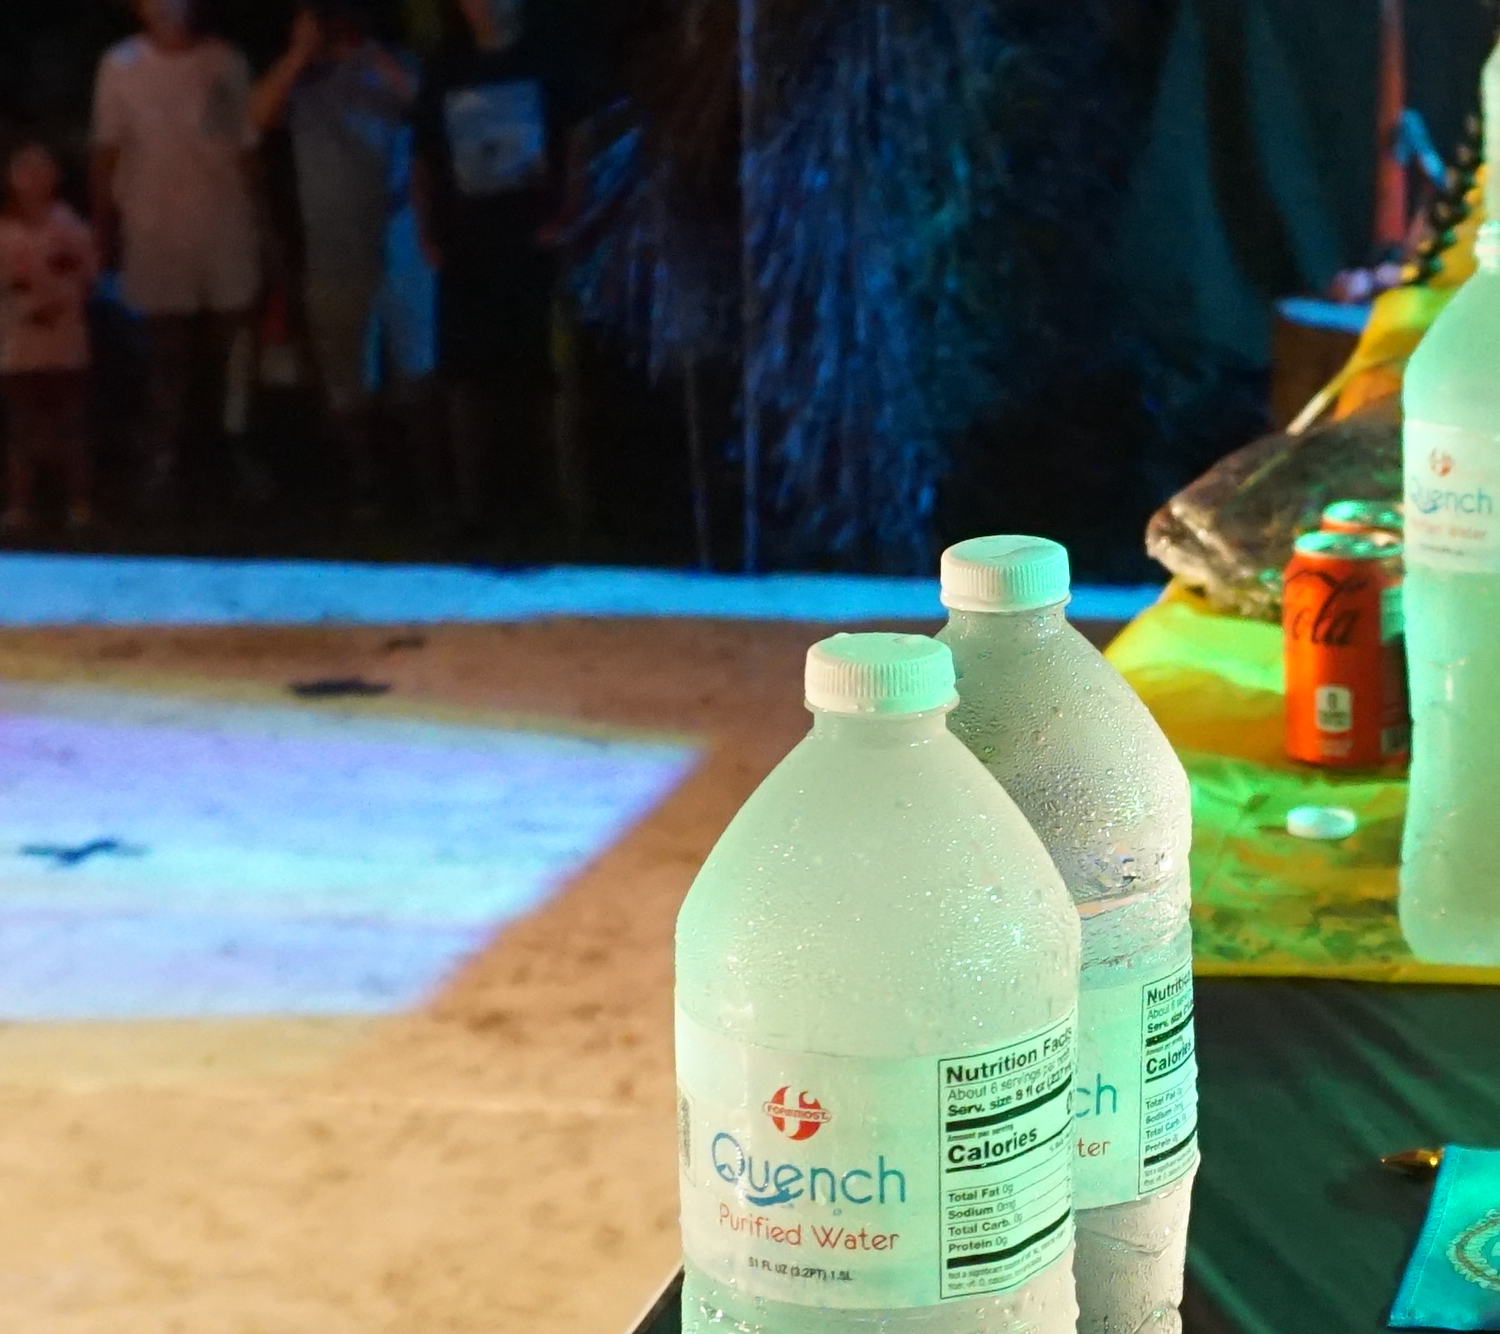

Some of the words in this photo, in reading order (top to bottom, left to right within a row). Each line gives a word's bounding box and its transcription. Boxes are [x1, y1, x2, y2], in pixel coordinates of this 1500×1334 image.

[946, 1048, 1038, 1084] Nutrition
[947, 1085, 987, 1102] About
[947, 1103, 986, 1117] Serv.
[947, 1127, 1038, 1164] Calories
[1076, 1137, 1111, 1158] ter
[711, 1131, 907, 1207] Quench
[948, 1190, 978, 1203] Total
[981, 1186, 1000, 1199] Fat
[947, 1206, 994, 1220] Sodium
[719, 1203, 802, 1246] Purified
[810, 1224, 900, 1252] Water
[948, 1223, 978, 1237] Total
[948, 1239, 993, 1254] Protein
